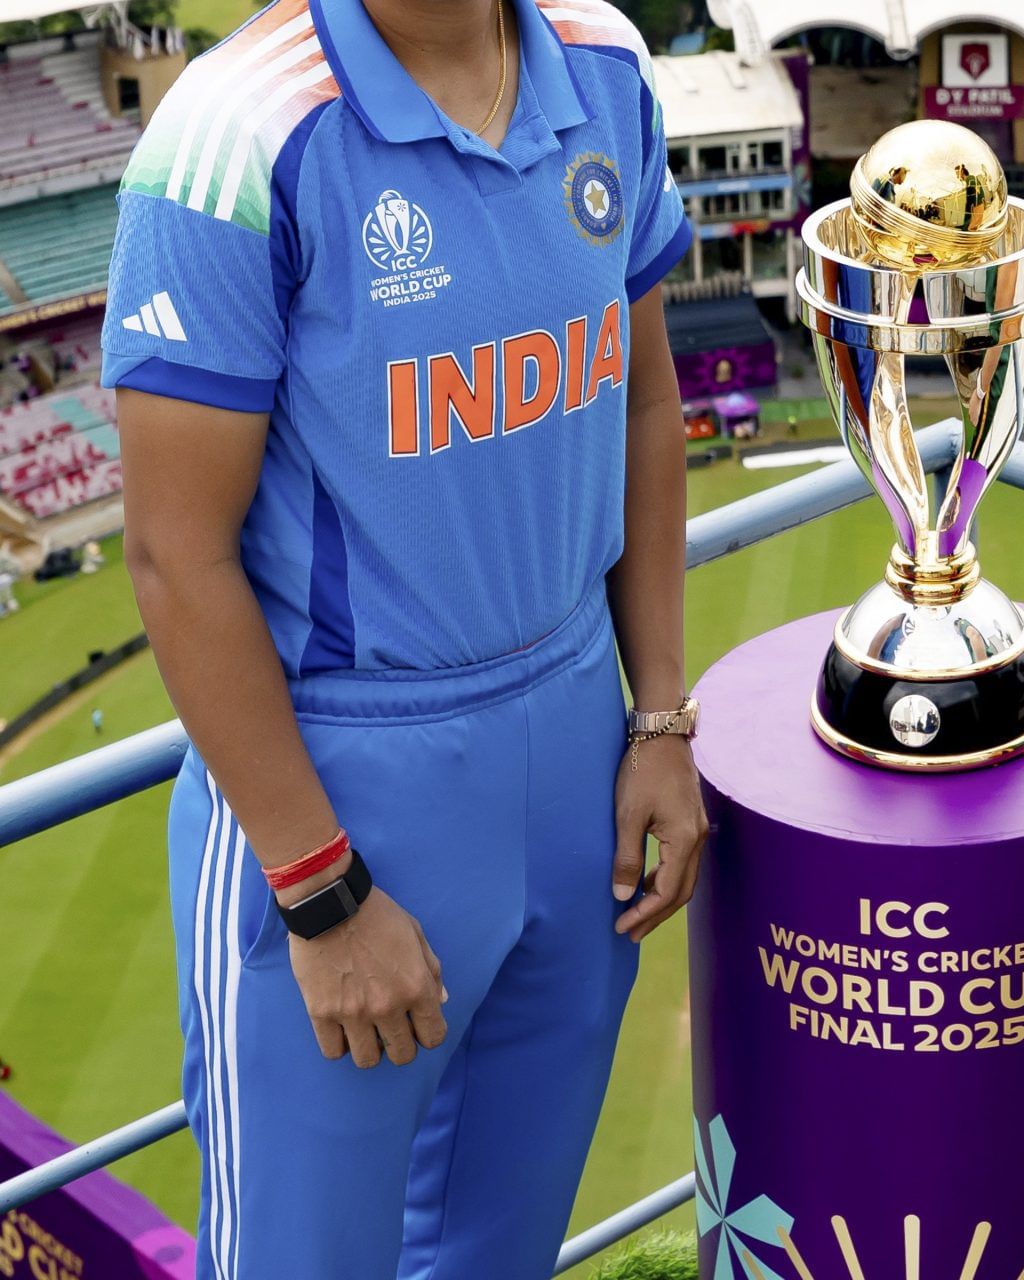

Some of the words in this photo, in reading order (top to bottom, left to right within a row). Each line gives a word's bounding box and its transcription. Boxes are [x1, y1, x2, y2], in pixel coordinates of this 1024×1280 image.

[371, 272, 408, 287] WOMEN'S
[409, 266, 445, 279] CRICKET
[391, 256, 417, 272] ICC
[370, 281, 420, 301] WORLD
[423, 274, 451, 289] CUP
[383, 296, 411, 307] INDIA
[412, 291, 436, 302] 2025
[387, 298, 623, 458] INDIA
[859, 898, 950, 939] ICC
[770, 923, 909, 973] WOMEN'S
[758, 946, 945, 1017] WORLD
[790, 1003, 905, 1051] FINAL
